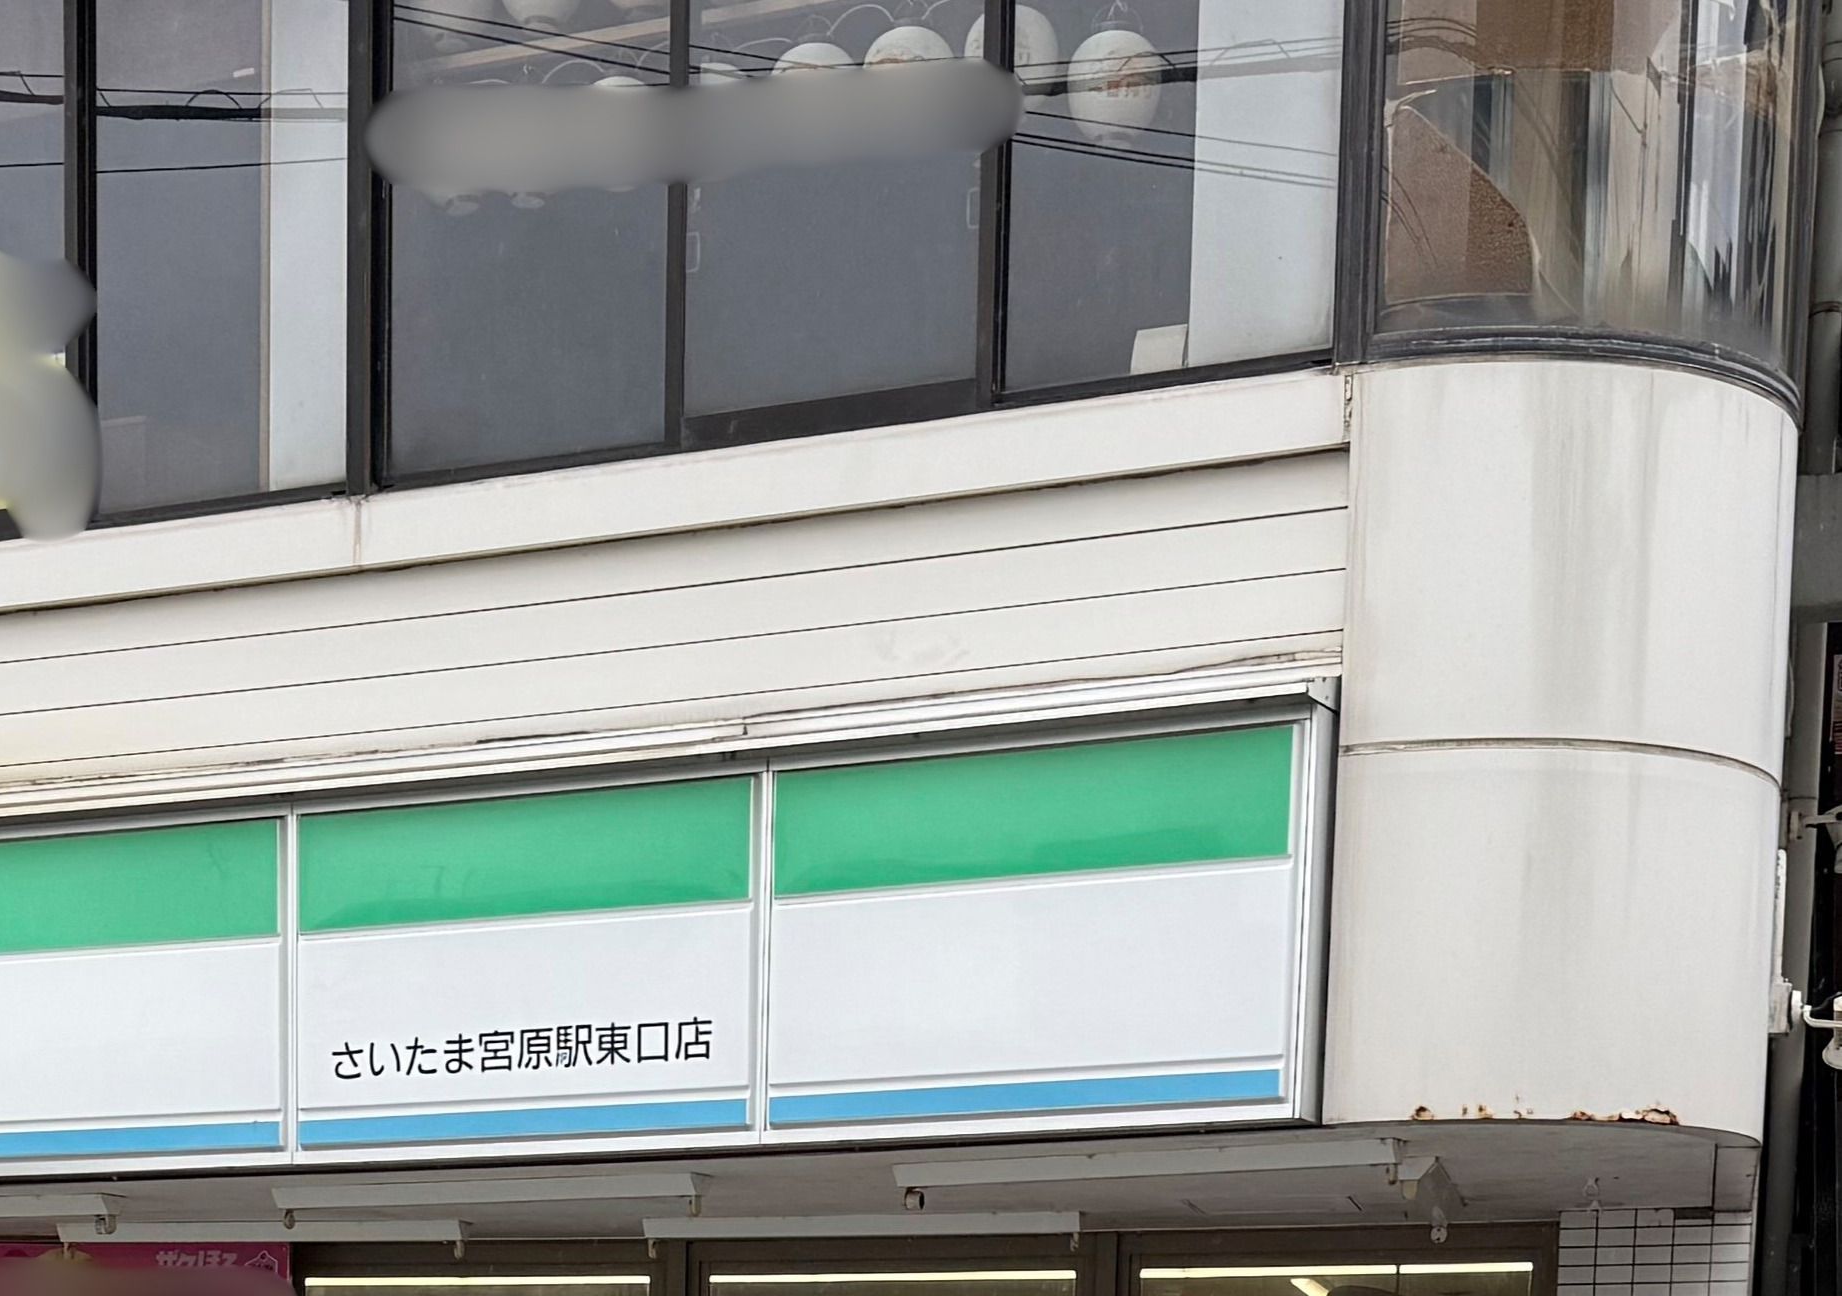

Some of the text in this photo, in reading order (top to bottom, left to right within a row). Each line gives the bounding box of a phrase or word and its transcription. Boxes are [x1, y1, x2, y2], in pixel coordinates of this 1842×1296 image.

[331, 1017, 713, 1080] さいたま宮原駅東口店
